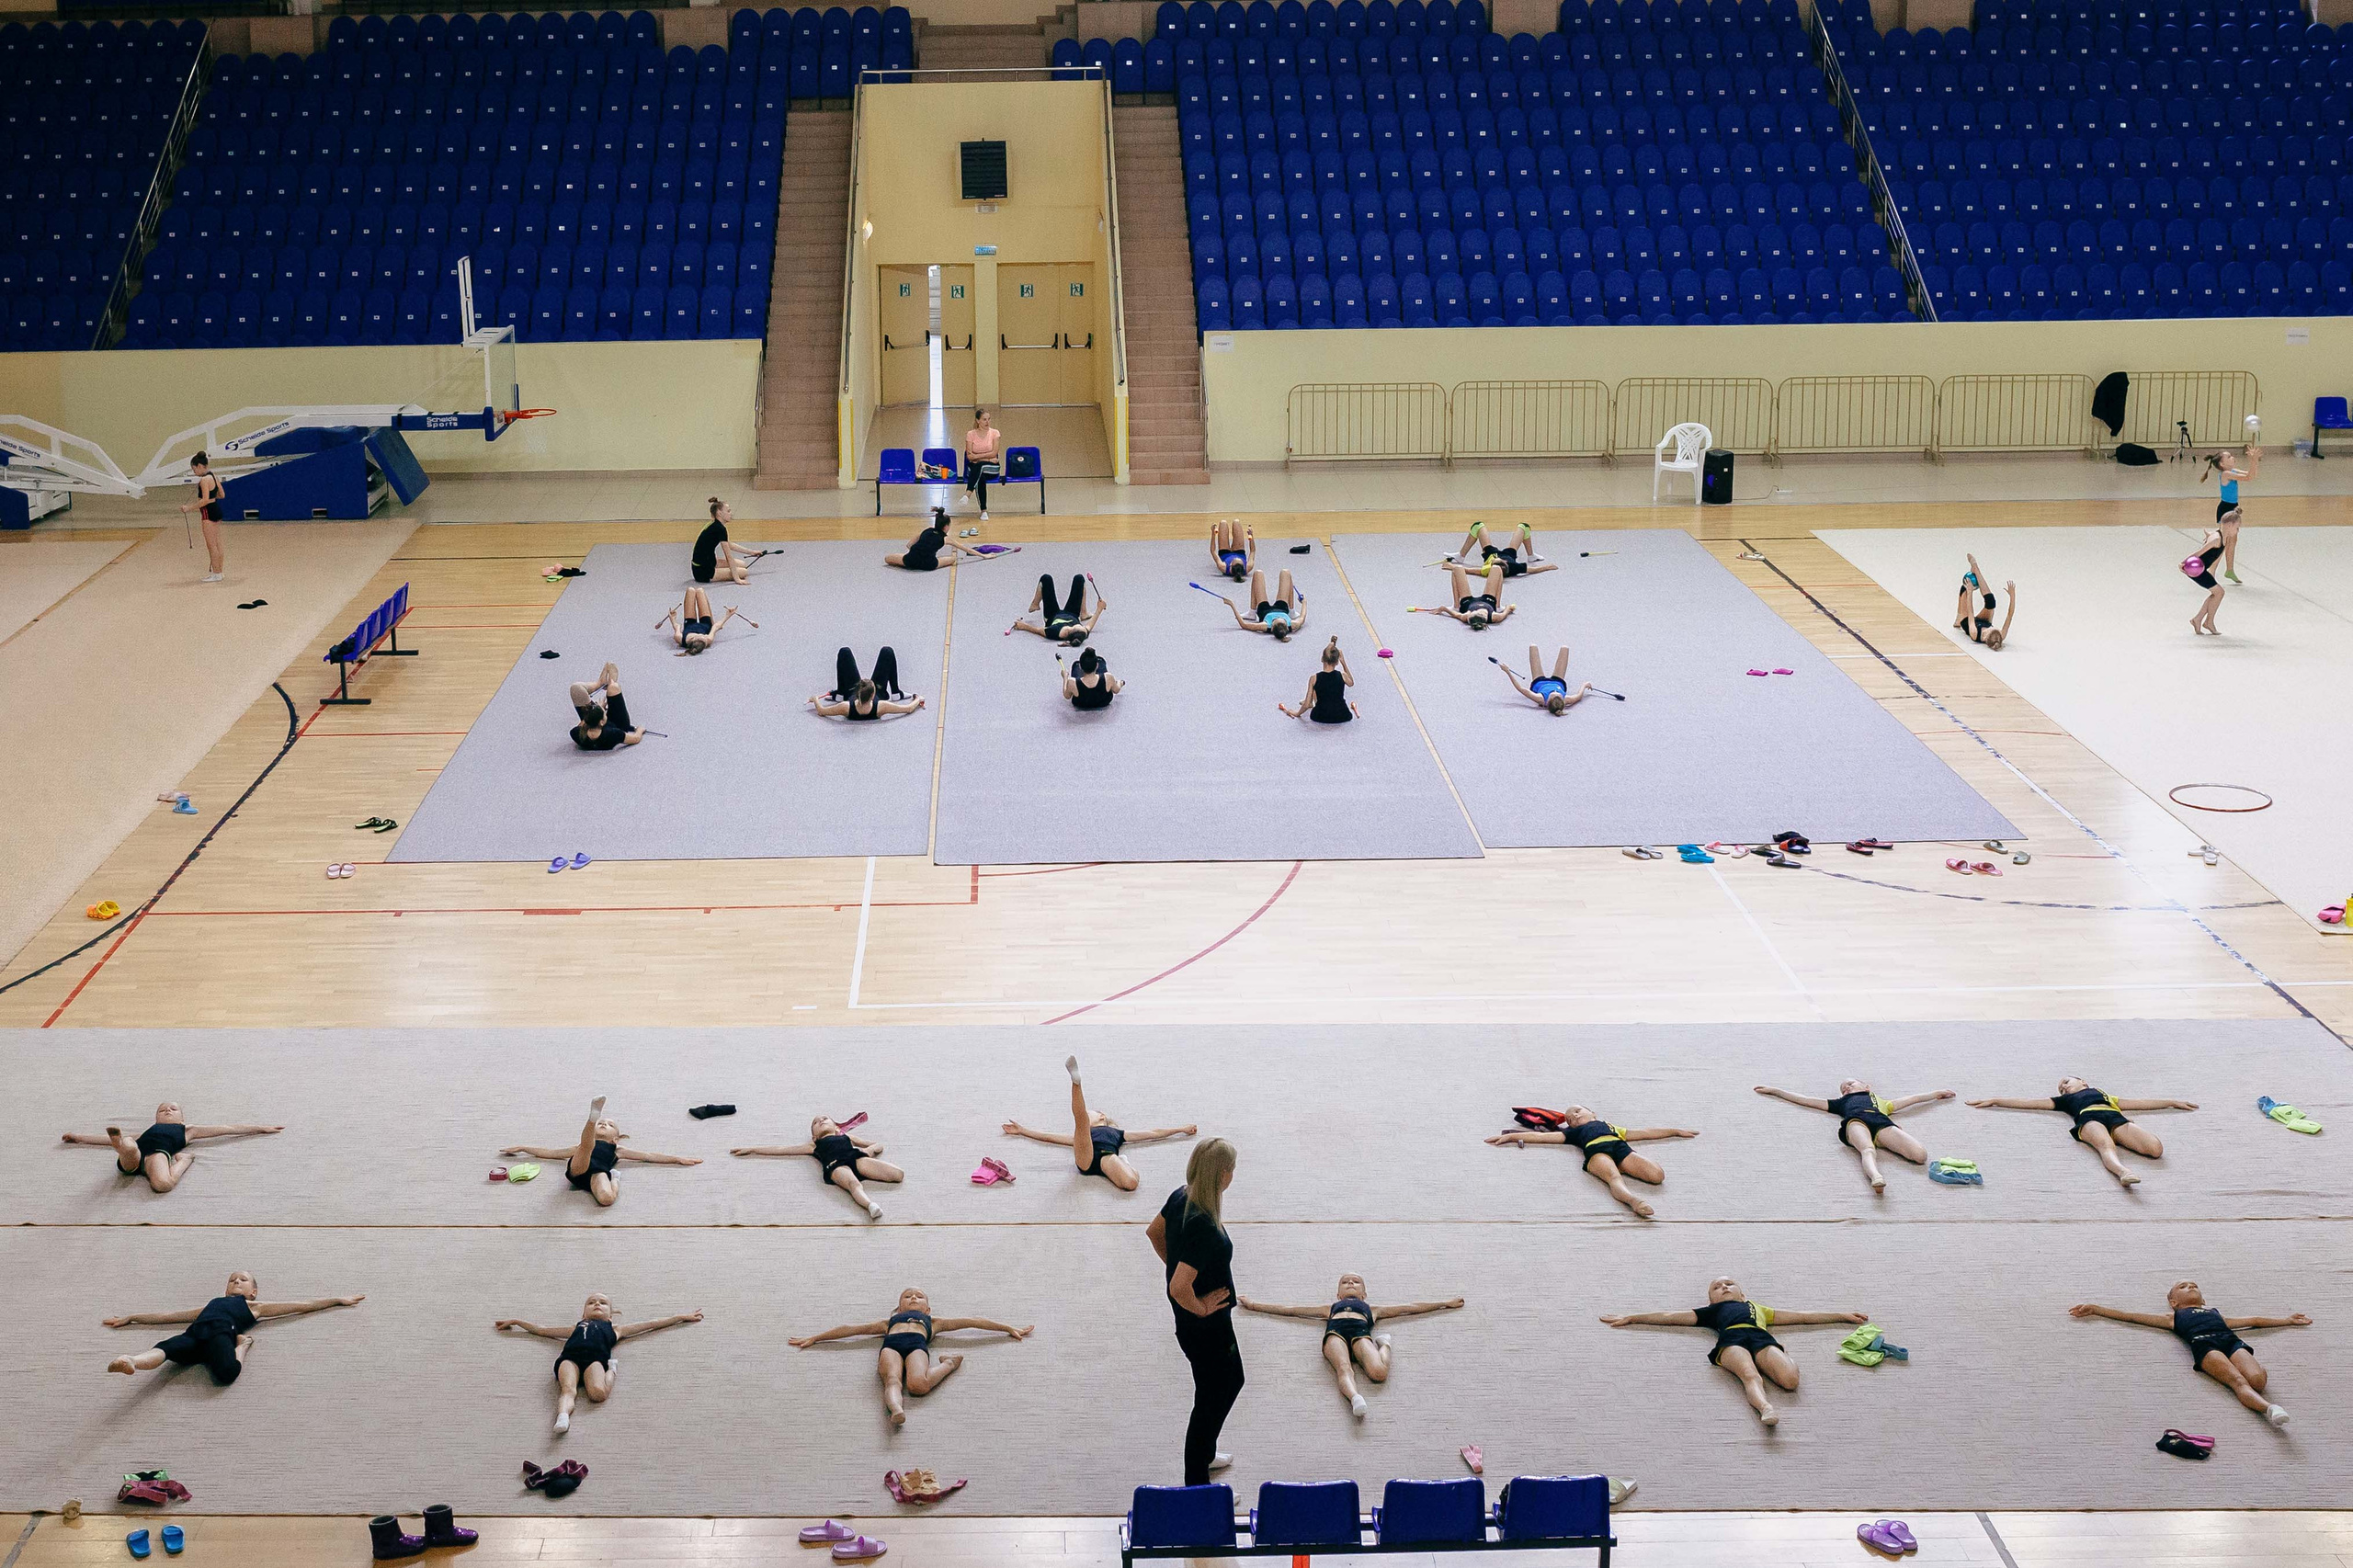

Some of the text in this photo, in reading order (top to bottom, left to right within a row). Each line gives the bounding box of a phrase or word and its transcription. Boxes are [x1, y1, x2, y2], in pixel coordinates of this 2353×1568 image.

[238, 422, 290, 445] Scheide Sports
[18, 446, 40, 458] Sports
